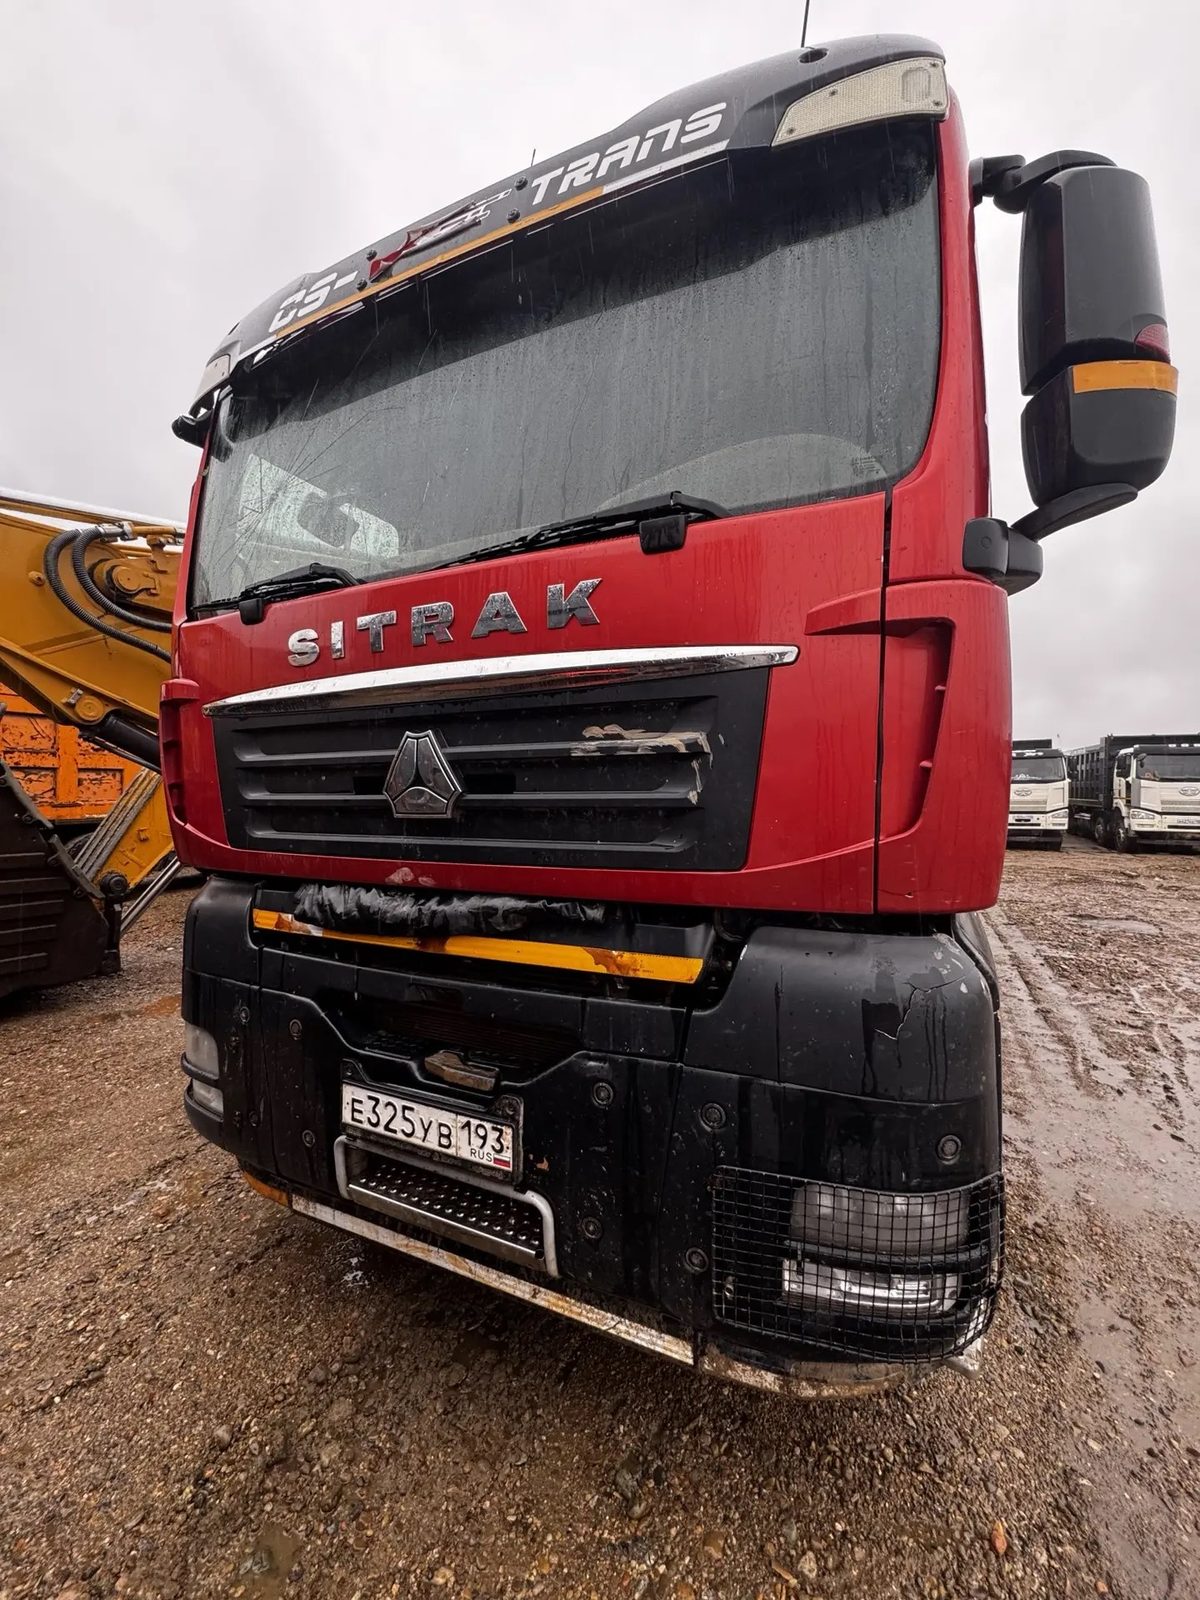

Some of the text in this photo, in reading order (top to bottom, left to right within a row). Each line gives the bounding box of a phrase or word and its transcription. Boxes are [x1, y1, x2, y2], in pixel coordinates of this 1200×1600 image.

[530, 101, 728, 206] TRANS
[287, 577, 603, 668] SITRAK
[460, 1119, 505, 1154] 193
[469, 1147, 493, 1163] RUS
